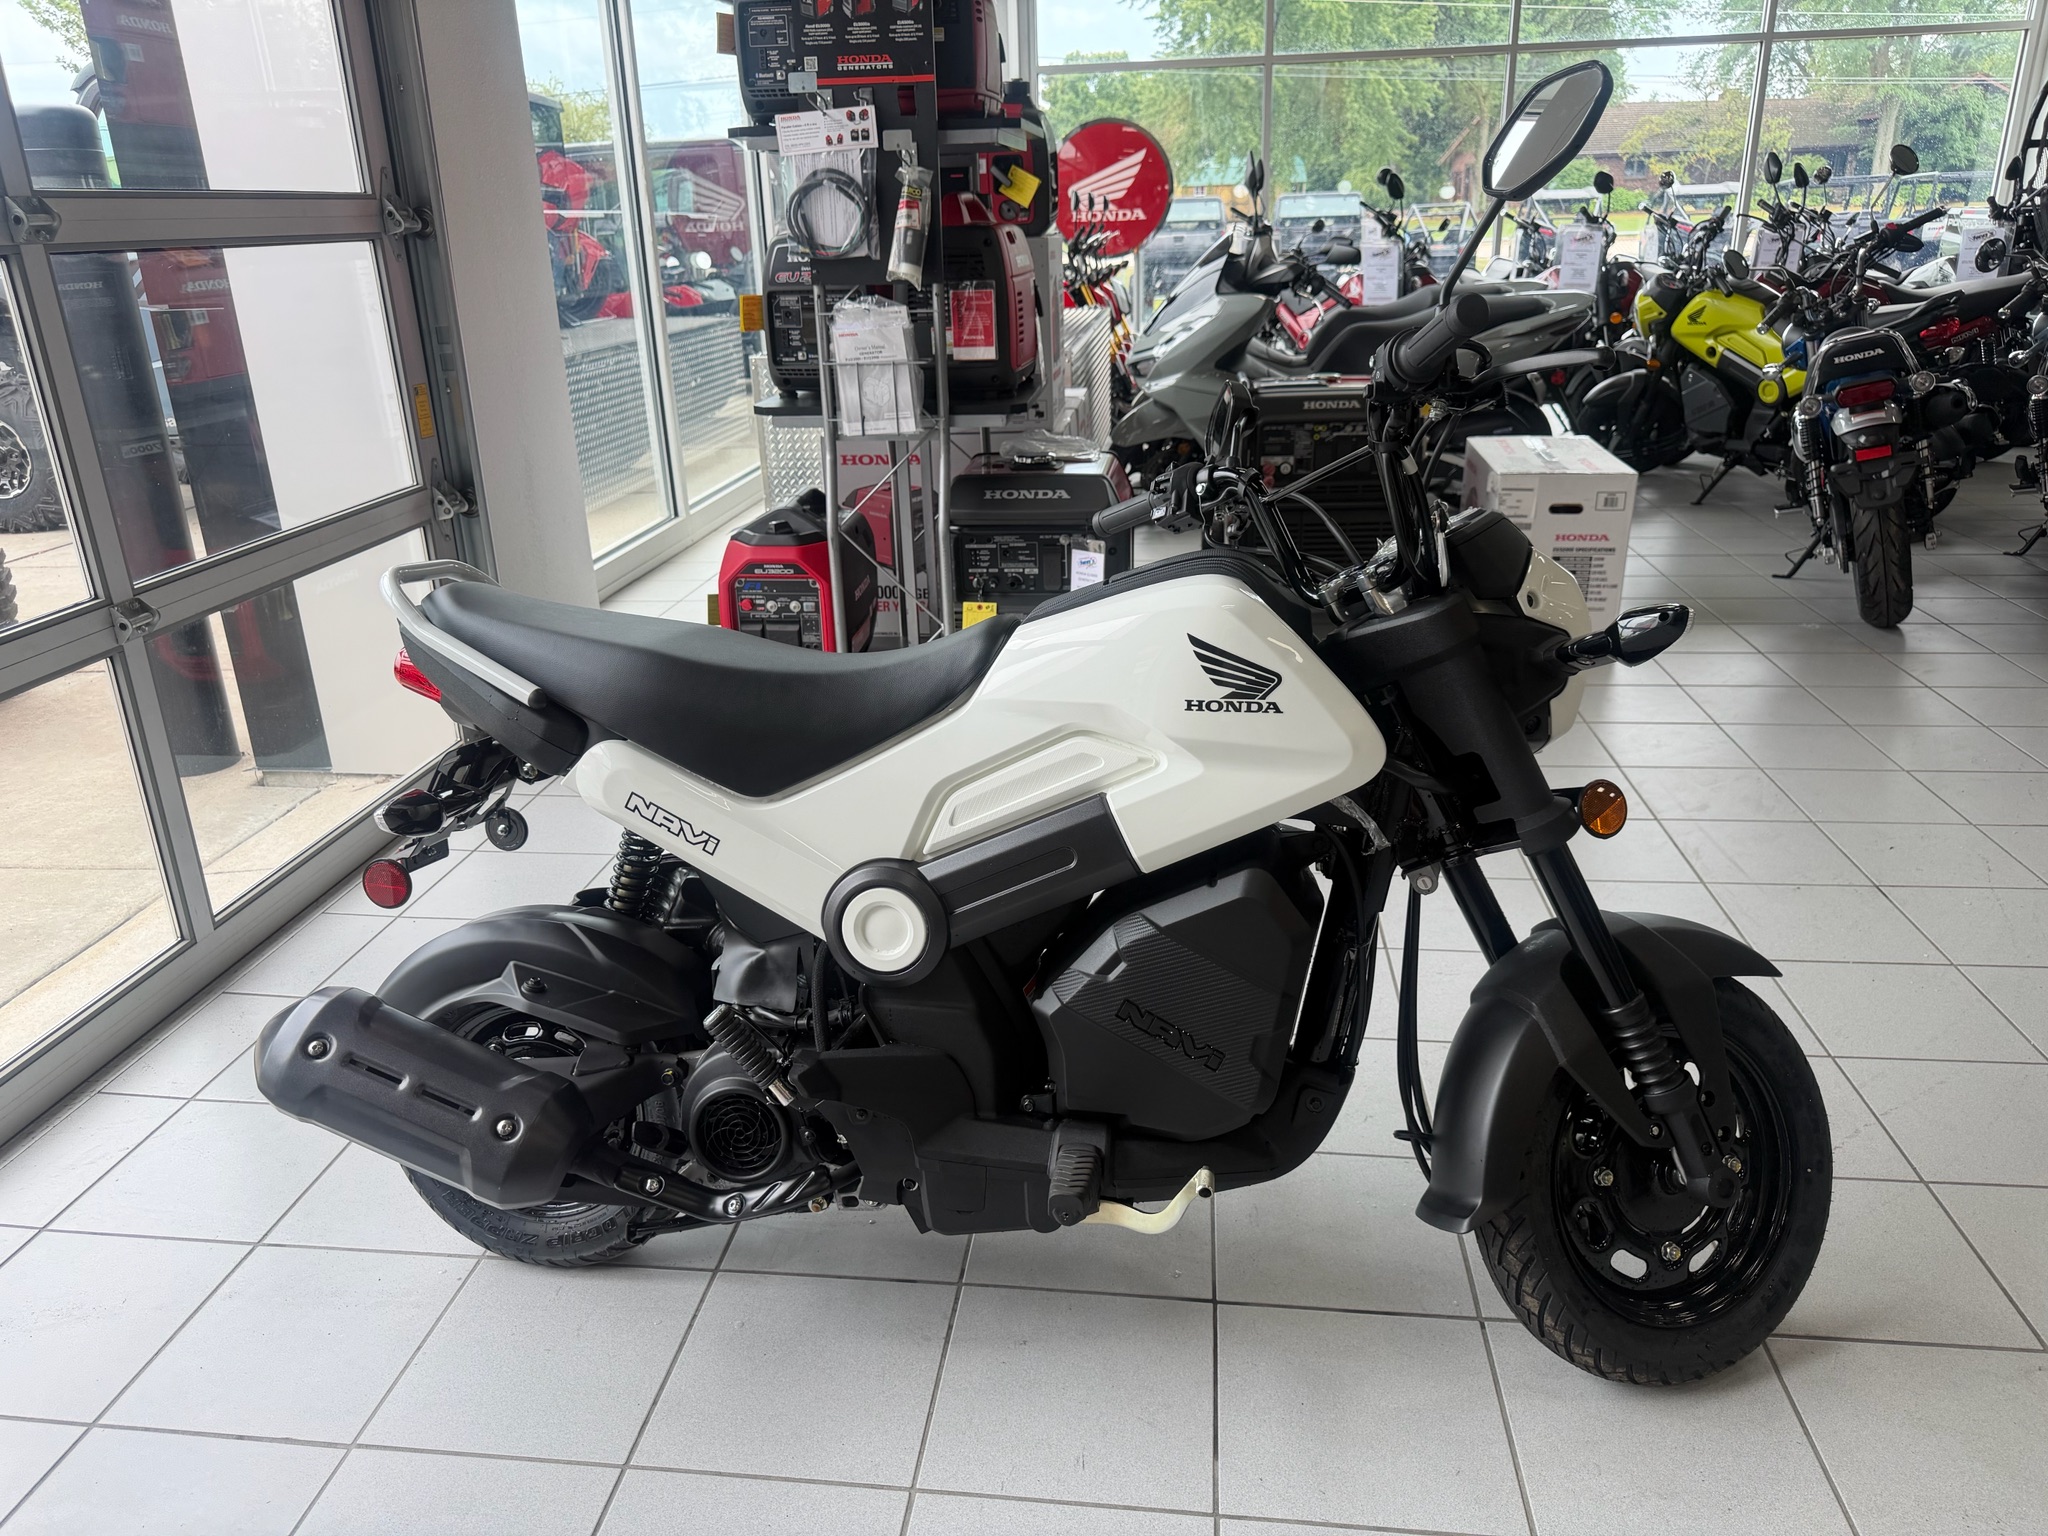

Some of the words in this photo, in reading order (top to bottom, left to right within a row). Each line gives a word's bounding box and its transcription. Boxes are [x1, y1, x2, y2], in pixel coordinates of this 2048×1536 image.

[837, 54, 893, 63] HONDA
[1072, 208, 1148, 223] HONDA
[775, 272, 812, 284] EU2
[1834, 348, 1885, 364] HONDA
[1303, 401, 1361, 409] HONDA
[840, 454, 921, 466] HONA
[983, 489, 1071, 500] HONDA
[1555, 533, 1610, 542] HONDA
[1184, 699, 1284, 714] HONDA
